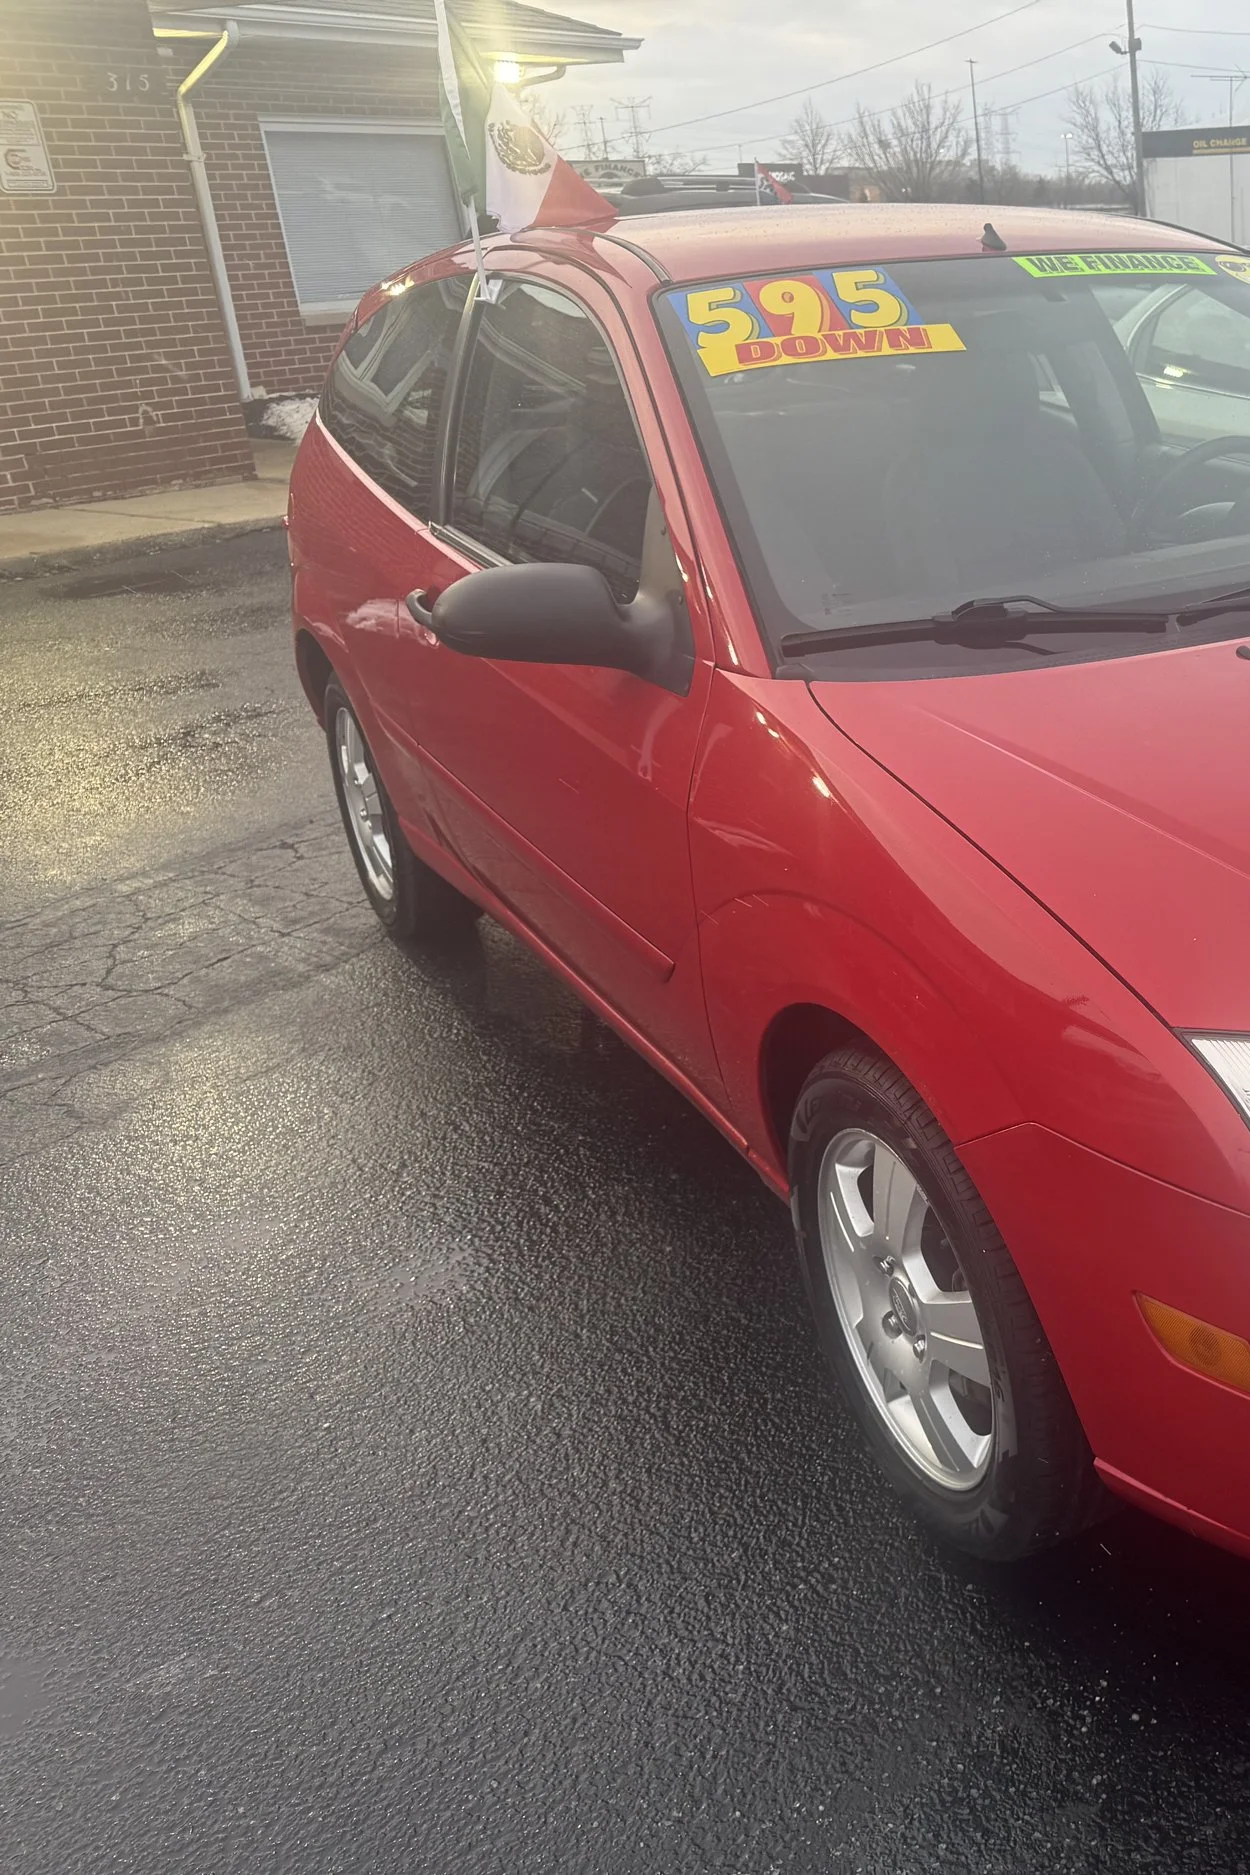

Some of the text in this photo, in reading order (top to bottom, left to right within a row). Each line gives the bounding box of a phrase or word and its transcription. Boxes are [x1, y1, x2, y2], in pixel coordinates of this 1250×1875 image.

[106, 72, 149, 91] 315
[1193, 139, 1208, 148] OIL
[1209, 137, 1248, 147] CHANGE
[1026, 255, 1206, 274] WE FINANCE
[686, 269, 909, 350] 595
[735, 326, 932, 366] DOWN
